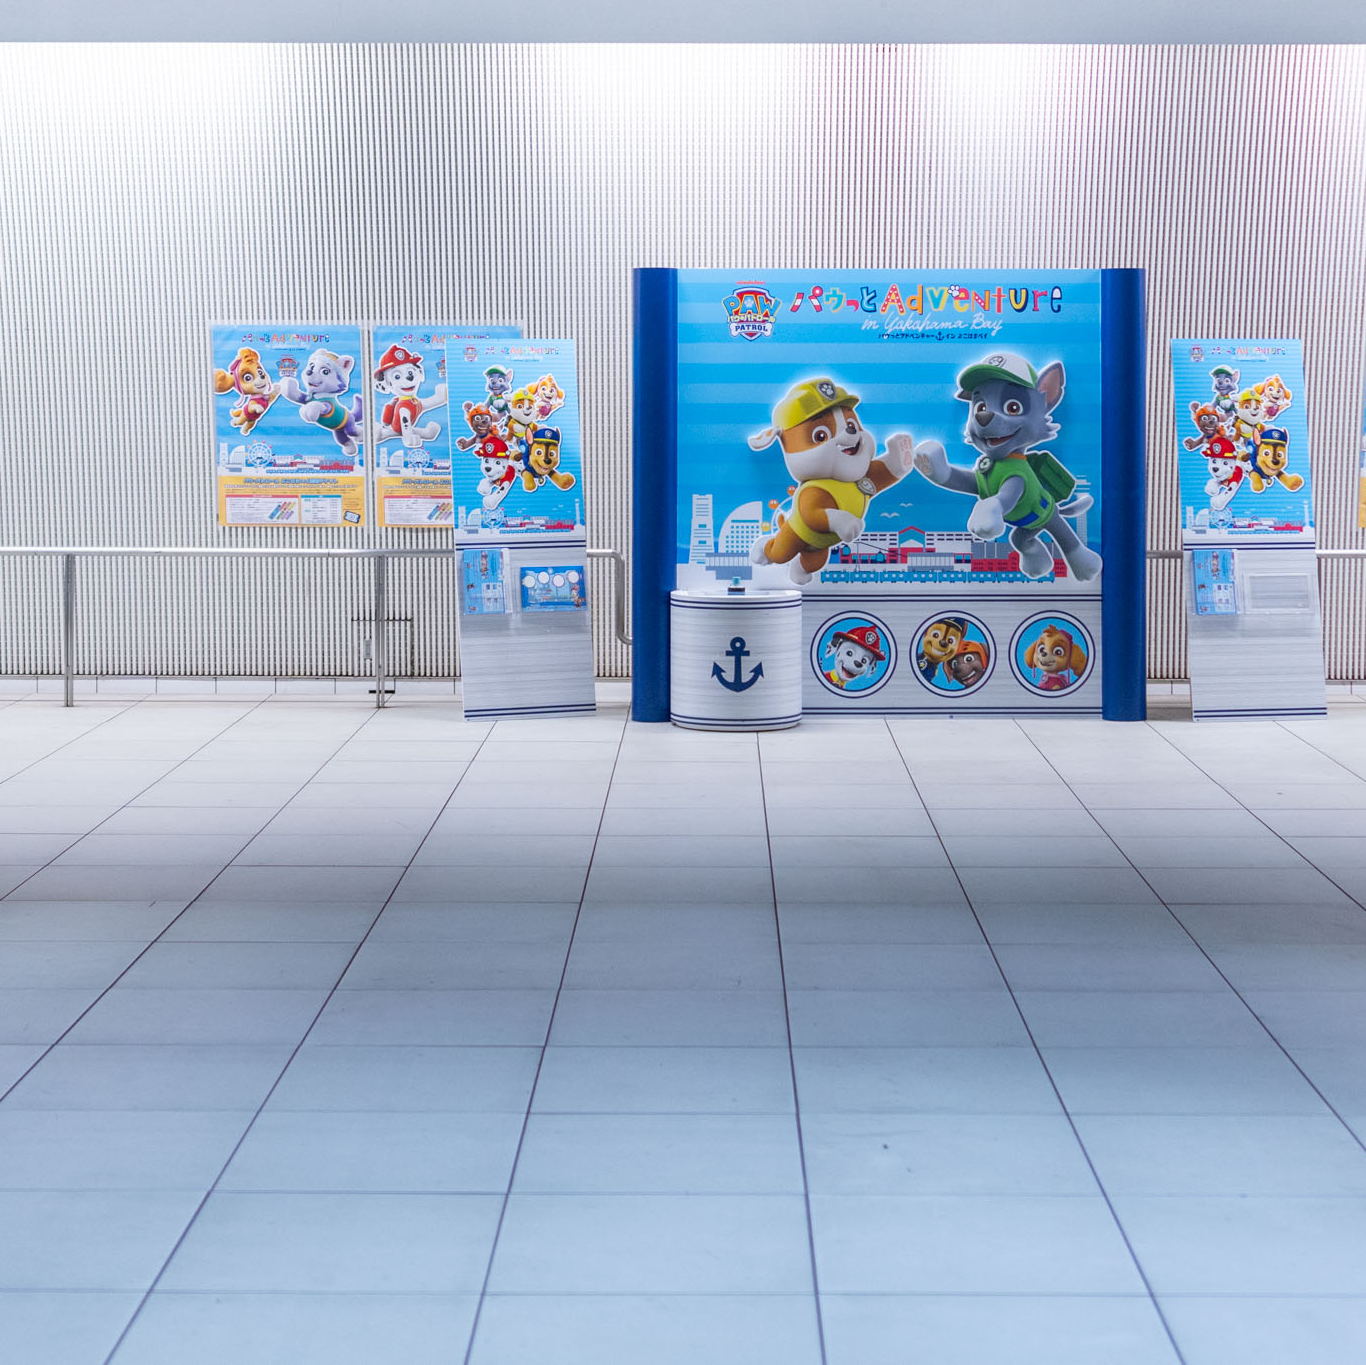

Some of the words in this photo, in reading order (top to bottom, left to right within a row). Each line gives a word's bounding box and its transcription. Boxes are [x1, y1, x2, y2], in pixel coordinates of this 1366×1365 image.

[722, 295, 782, 316] PAW
[735, 324, 768, 332] PATROL
[861, 315, 879, 330] in
[970, 312, 1003, 336] Bay
